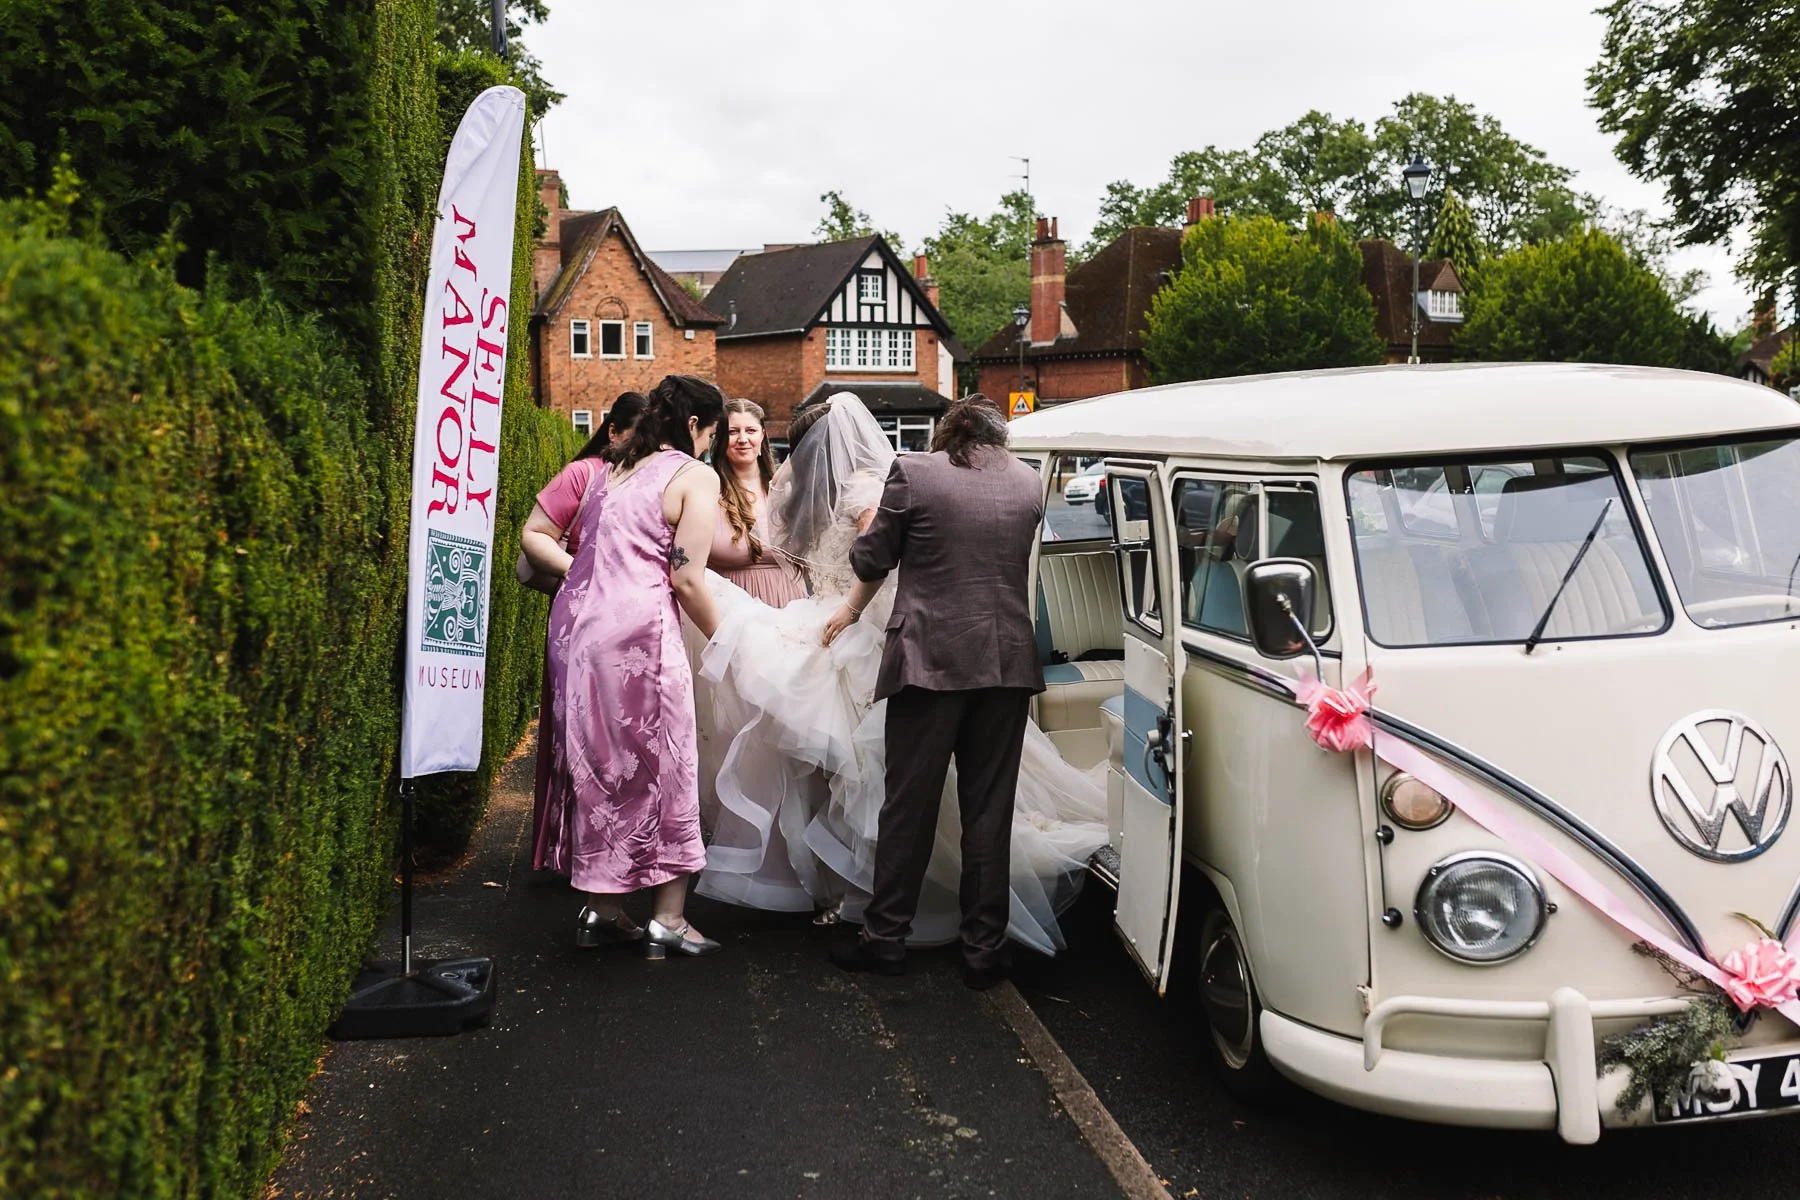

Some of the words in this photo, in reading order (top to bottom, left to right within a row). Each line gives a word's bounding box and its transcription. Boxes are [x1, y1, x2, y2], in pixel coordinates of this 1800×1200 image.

[427, 203, 477, 519] MANOR
[465, 287, 507, 530] SELLY
[1654, 711, 1791, 860] VW
[1671, 1063, 1761, 1117] MY
